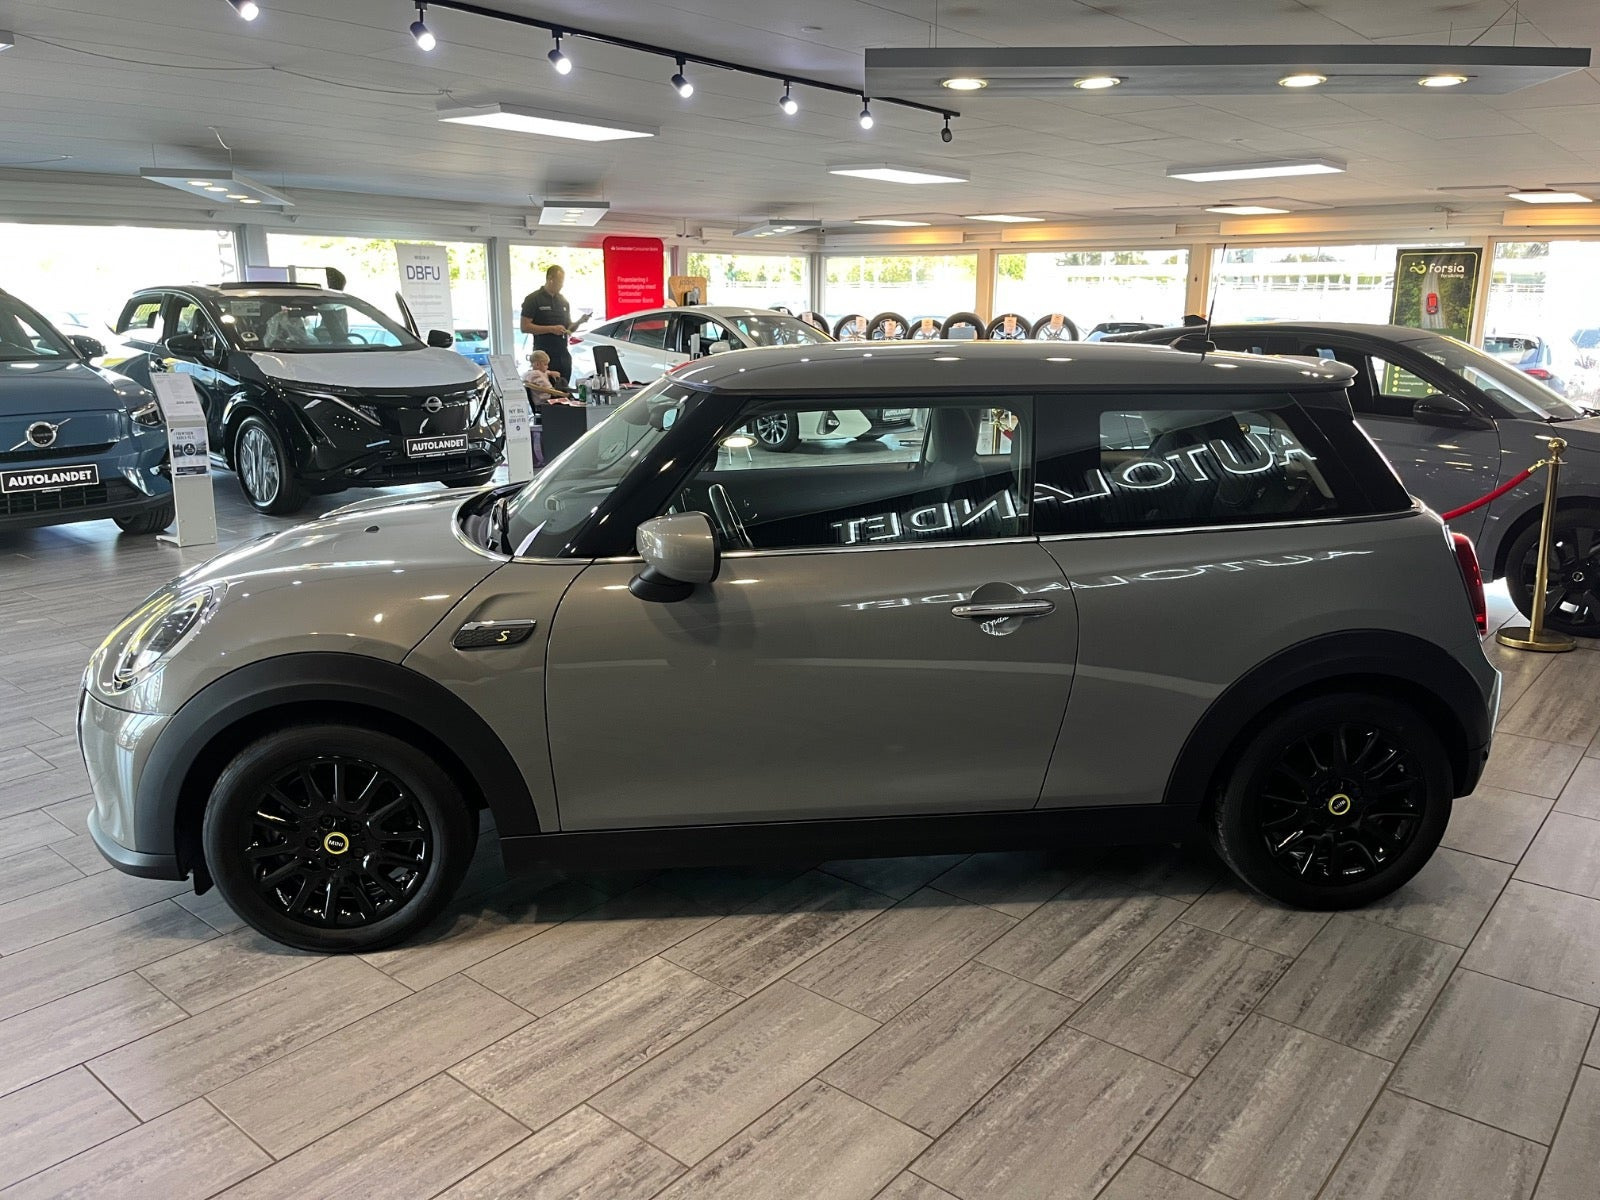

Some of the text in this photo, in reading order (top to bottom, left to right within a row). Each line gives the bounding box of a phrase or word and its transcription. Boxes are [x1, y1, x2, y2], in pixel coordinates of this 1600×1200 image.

[406, 265, 441, 281] DBFU
[1429, 262, 1465, 273] forsia
[617, 276, 646, 285] Finansiering
[617, 284, 645, 292] samarbejde
[411, 439, 464, 452] AUTOLANDET
[8, 470, 92, 487] AUTOLANDET
[496, 630, 511, 642] S
[328, 839, 344, 848] MINI
